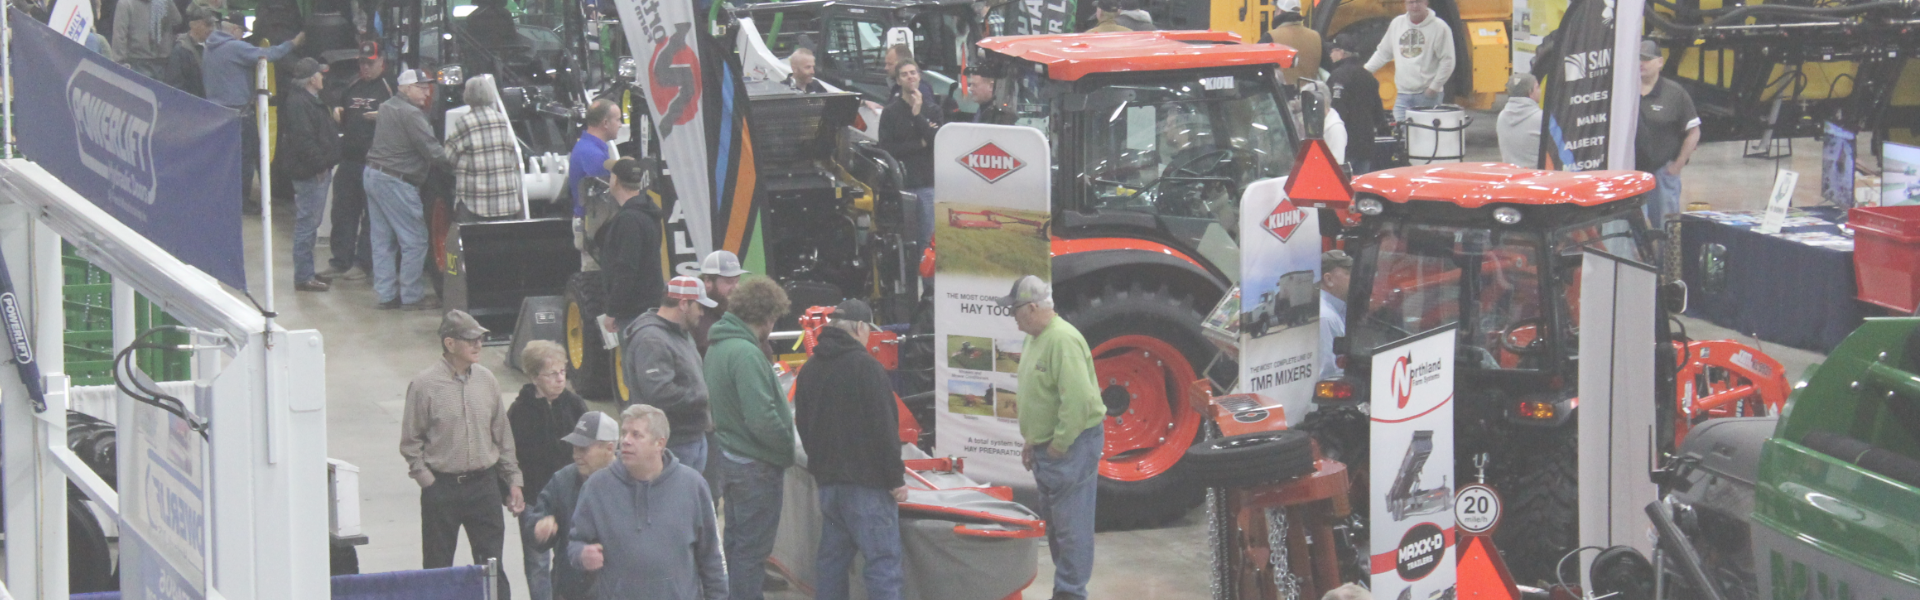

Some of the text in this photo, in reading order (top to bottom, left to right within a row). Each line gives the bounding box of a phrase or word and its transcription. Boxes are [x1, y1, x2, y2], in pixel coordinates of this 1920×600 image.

[1588, 48, 1612, 70] SAN
[1205, 76, 1235, 90] KIOTI
[72, 86, 150, 171] POWERLIFT
[968, 153, 1015, 170] KUHN
[1268, 209, 1301, 230] KUHN
[946, 292, 959, 300] THE
[960, 293, 979, 301] MOST
[960, 303, 1011, 317] HAY TOO
[3, 297, 30, 358] POWERLIFT
[1251, 363, 1312, 392] TMR MIXERS
[974, 437, 989, 445] total
[979, 446, 1021, 457] PREPARATIO
[1464, 496, 1489, 514] 20
[1398, 533, 1443, 564] MAXX-D
[1407, 555, 1434, 570] TRAILERS
